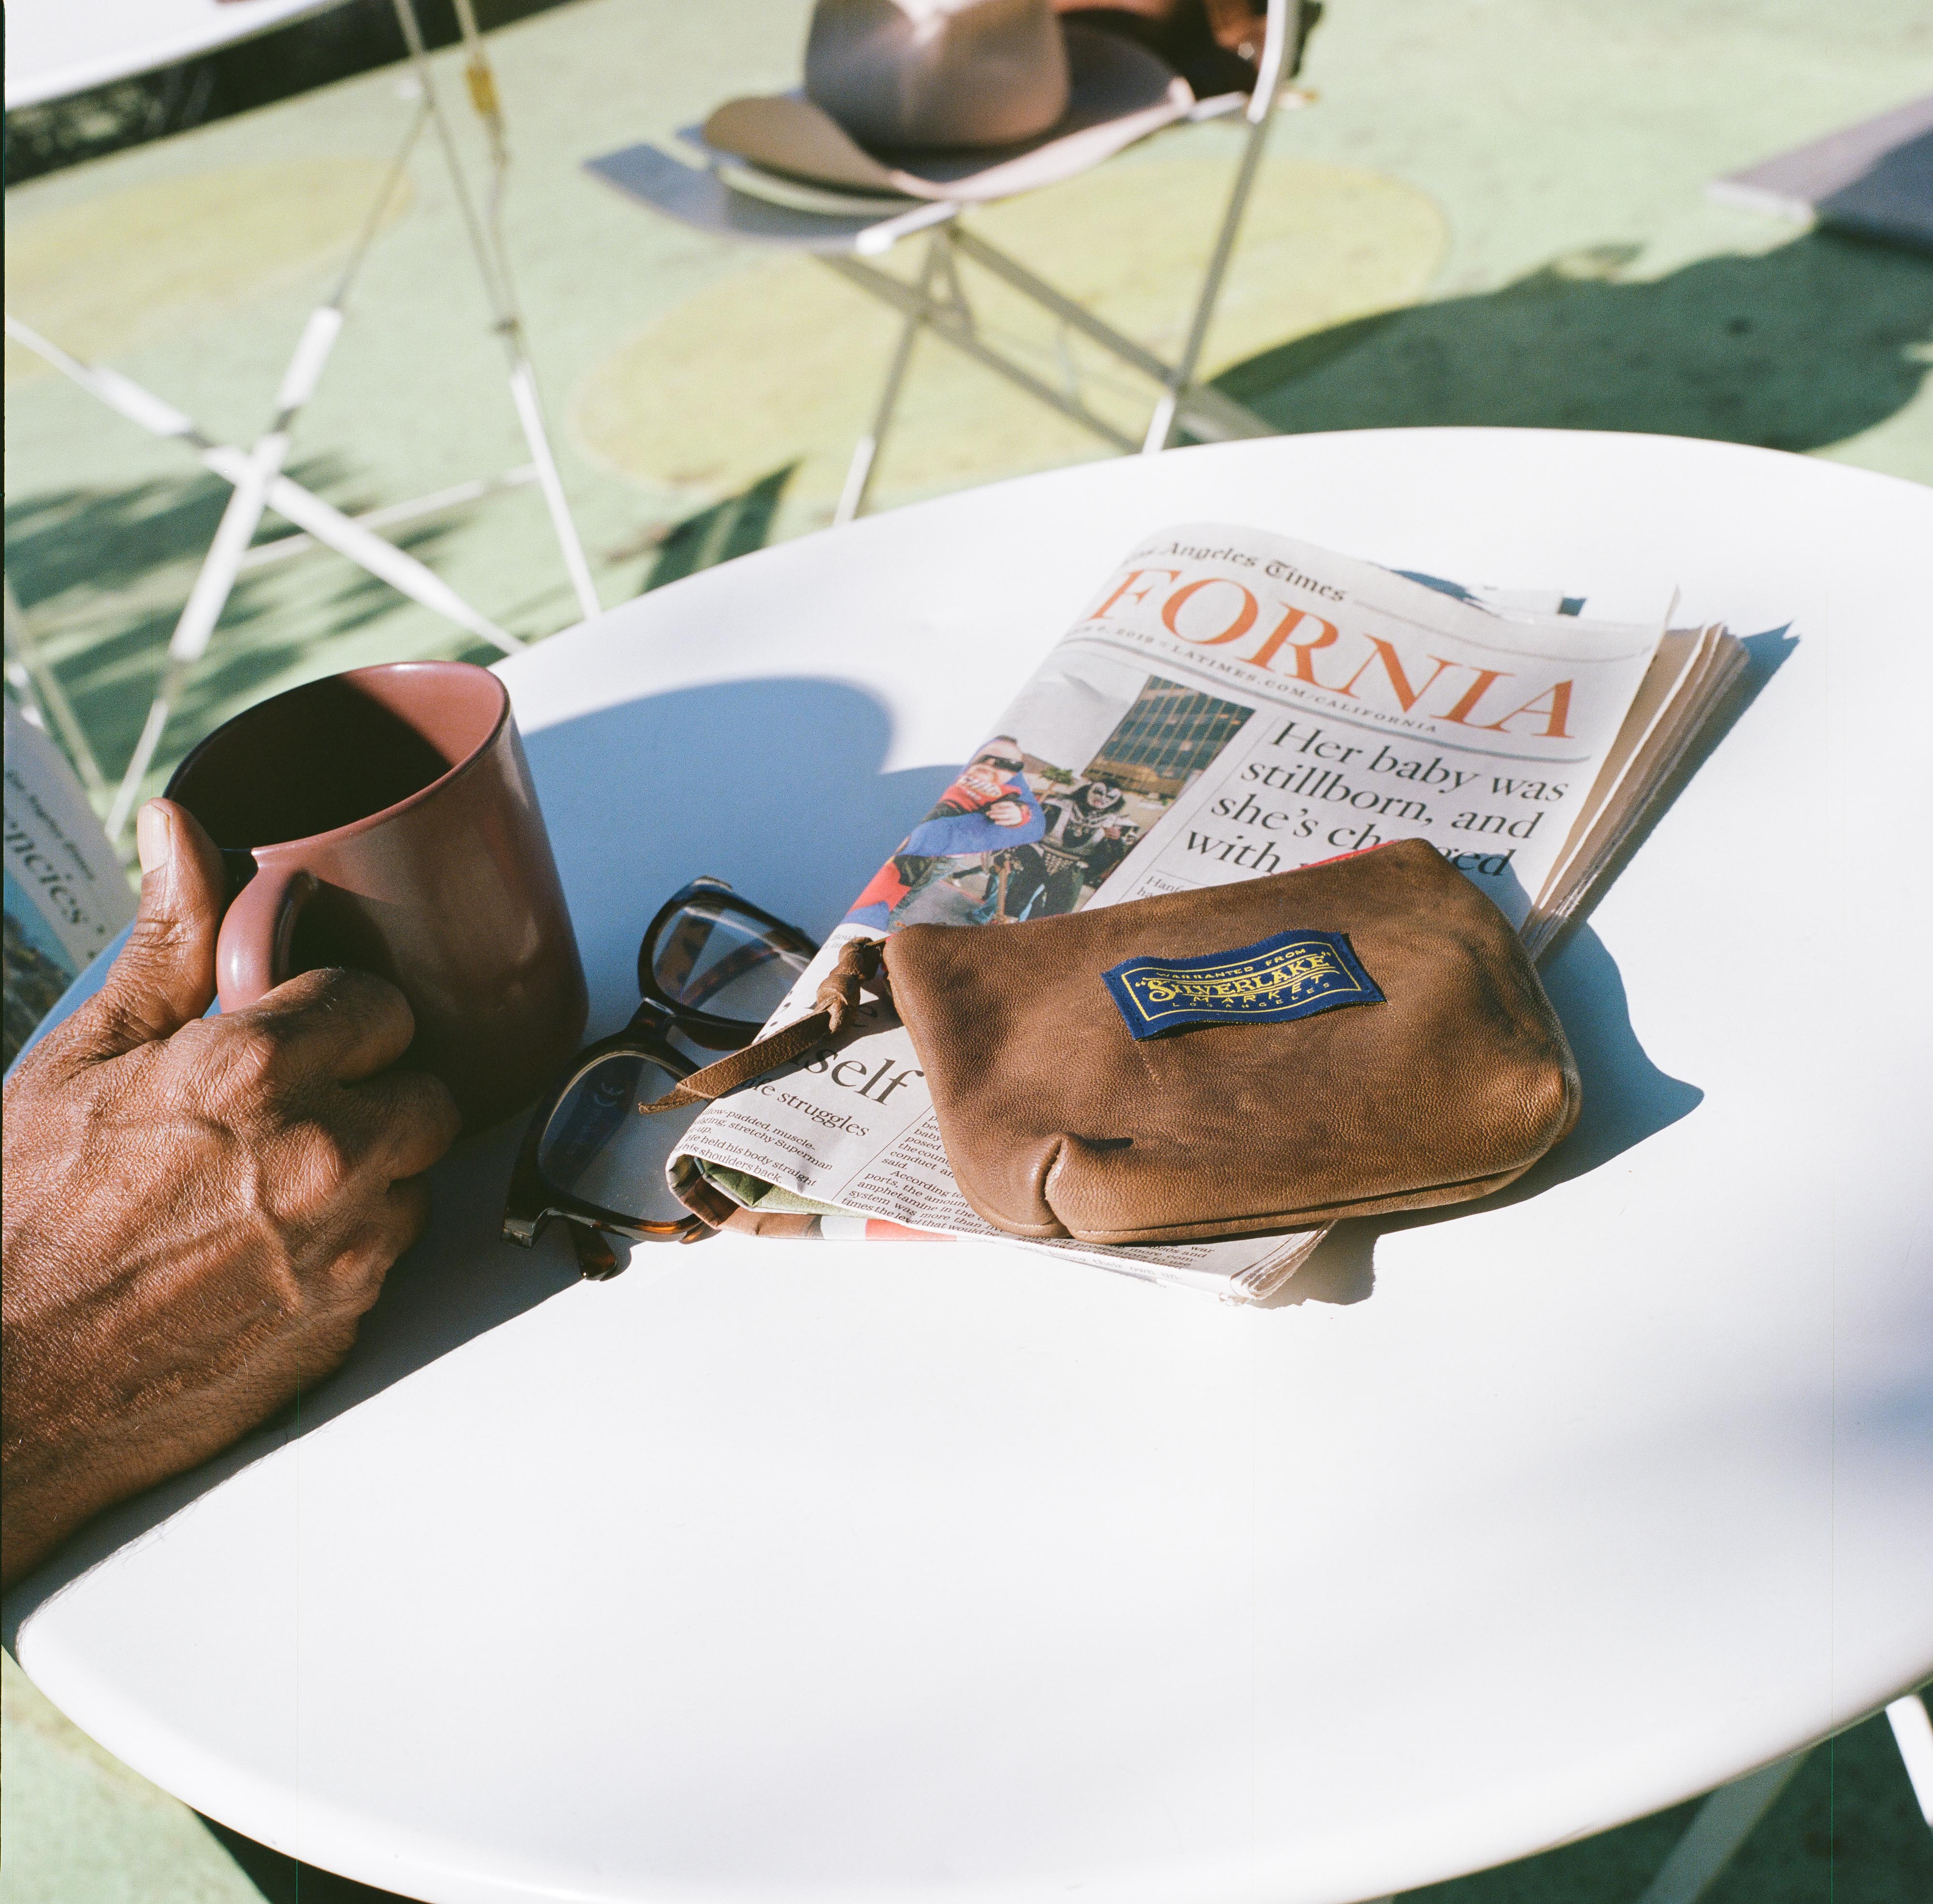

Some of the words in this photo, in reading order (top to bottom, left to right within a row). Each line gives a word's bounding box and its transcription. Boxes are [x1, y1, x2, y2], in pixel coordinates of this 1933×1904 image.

[1163, 542, 1257, 567] Angeles
[1264, 559, 1347, 603] Times
[1084, 567, 1574, 738] FORNIA
[1269, 720, 1364, 766] Her
[1369, 745, 1481, 793] baby
[1490, 778, 1570, 802] was
[1241, 759, 1433, 825] stillborn,
[1451, 810, 1545, 840] and
[1186, 831, 1282, 874] with
[1212, 792, 1319, 837] she's
[1327, 822, 1516, 876] ched
[4, 821, 89, 925] ncies
[1155, 966, 1254, 980] WARRANTED
[1265, 948, 1306, 966] FROM
[1193, 973, 1324, 1003] MARKET
[1225, 982, 1330, 1009] ANGELES
[789, 1048, 925, 1106] self
[777, 1092, 869, 1137] struggles
[728, 1122, 774, 1143] stretchy
[774, 1139, 833, 1170] Superman
[772, 1127, 816, 1150] muscle-
[904, 1137, 942, 1151] posed
[913, 1128, 941, 1141] baby
[682, 1143, 699, 1153] his
[699, 1149, 753, 1171] shoulders
[753, 1165, 781, 1183] back.
[700, 1136, 727, 1149] held
[725, 1143, 744, 1154] his
[743, 1149, 773, 1165] body
[772, 1161, 817, 1187] straight
[881, 1158, 907, 1170] said.
[890, 1151, 938, 1170] conduct
[898, 1142, 917, 1153] the
[918, 1150, 951, 1168] count
[857, 1181, 938, 1211] amphetamine
[955, 1209, 975, 1218] the
[864, 1173, 898, 1188] ports,
[903, 1184, 923, 1197] the
[924, 1195, 970, 1208] amount
[890, 1170, 951, 1197] According
[841, 1197, 874, 1211] times
[875, 1206, 894, 1217] the
[894, 1212, 922, 1224] level
[921, 1220, 948, 1229] that
[949, 1224, 985, 1234] would
[849, 1189, 891, 1205] system
[894, 1202, 918, 1216] was
[953, 1217, 981, 1228] than
